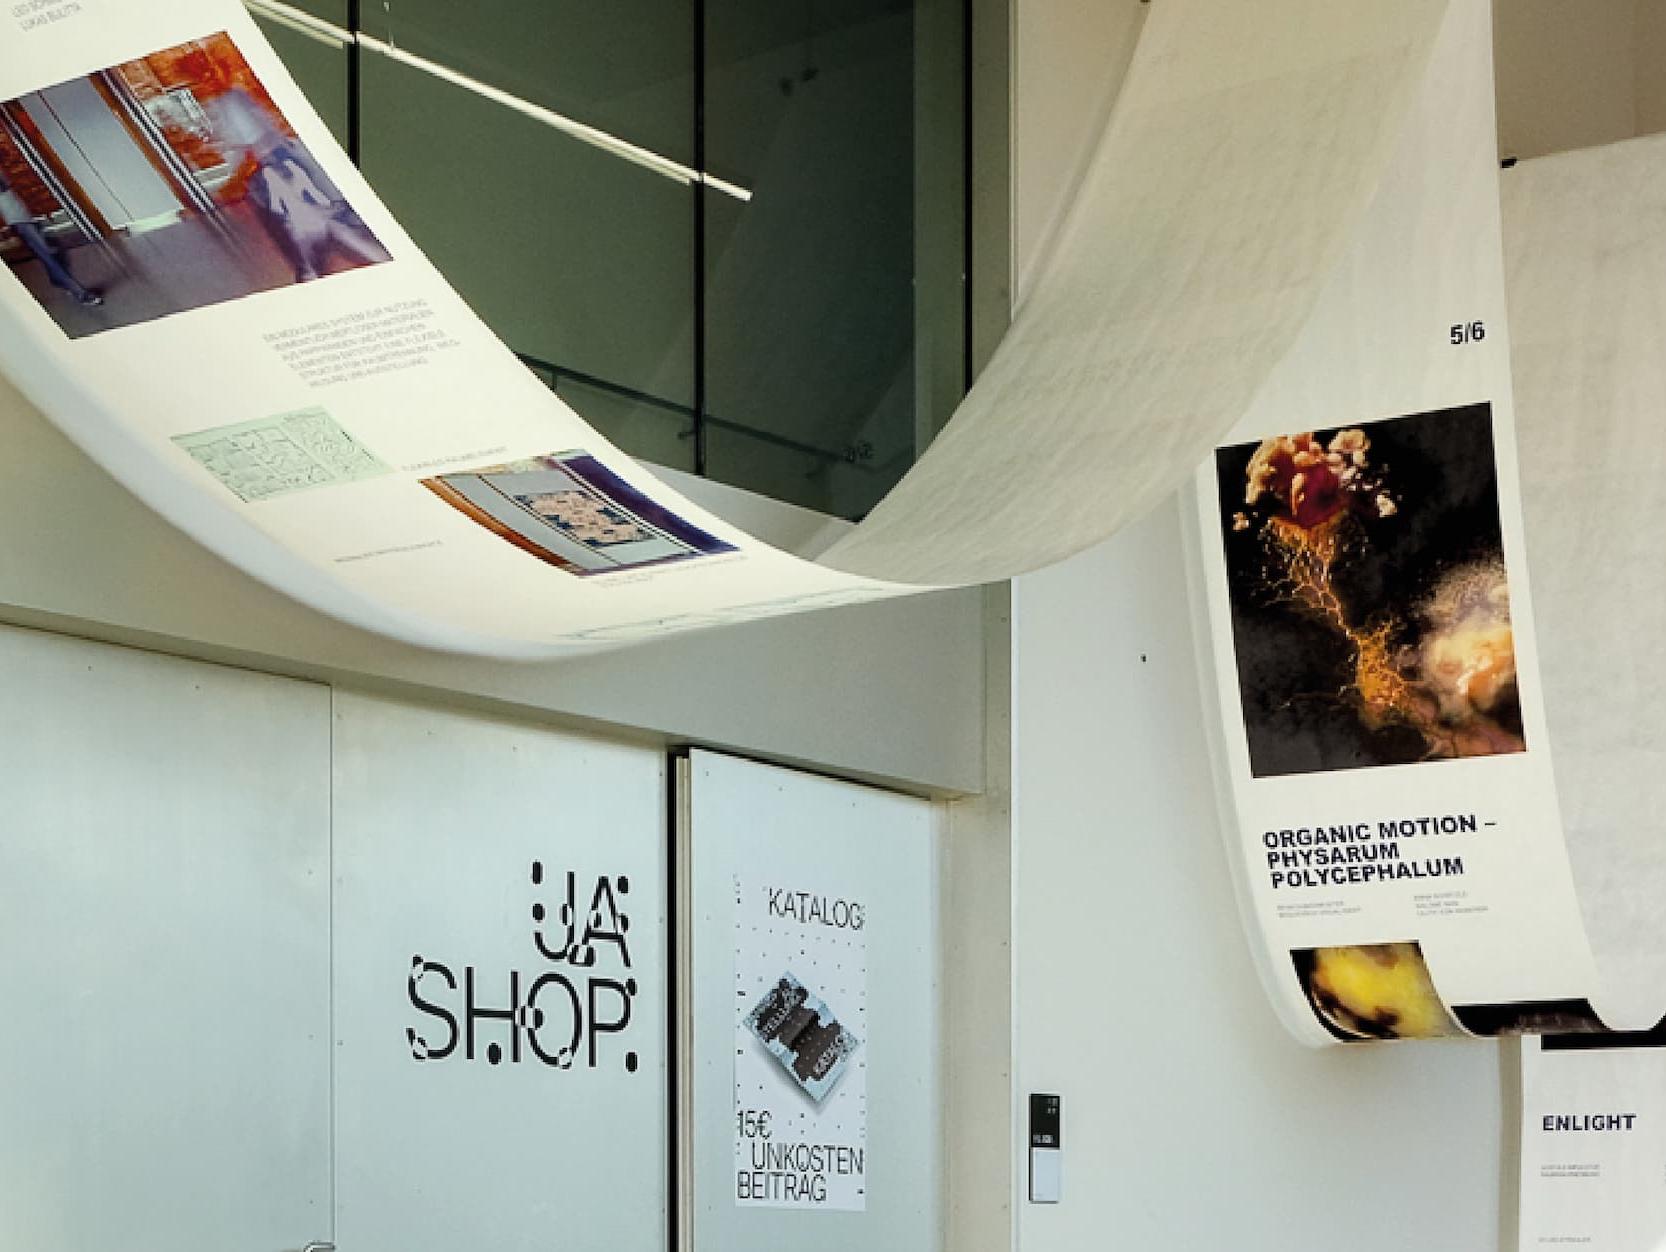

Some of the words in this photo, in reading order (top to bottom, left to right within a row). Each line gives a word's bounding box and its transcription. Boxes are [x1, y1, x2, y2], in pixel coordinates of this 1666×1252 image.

[1450, 321, 1485, 345] 5/6
[1263, 823, 1371, 849] ORGANIC
[1378, 814, 1477, 838] MOTION
[1267, 842, 1400, 869] PHYSARUM
[1271, 857, 1464, 889] POLYCEPHALUM
[768, 887, 864, 930] KATALOG
[737, 1109, 772, 1140] 15€
[1543, 1114, 1637, 1130] ENLIGHT
[751, 1142, 864, 1175] UNKOSTEN
[737, 1170, 827, 1202] BEITRAG
